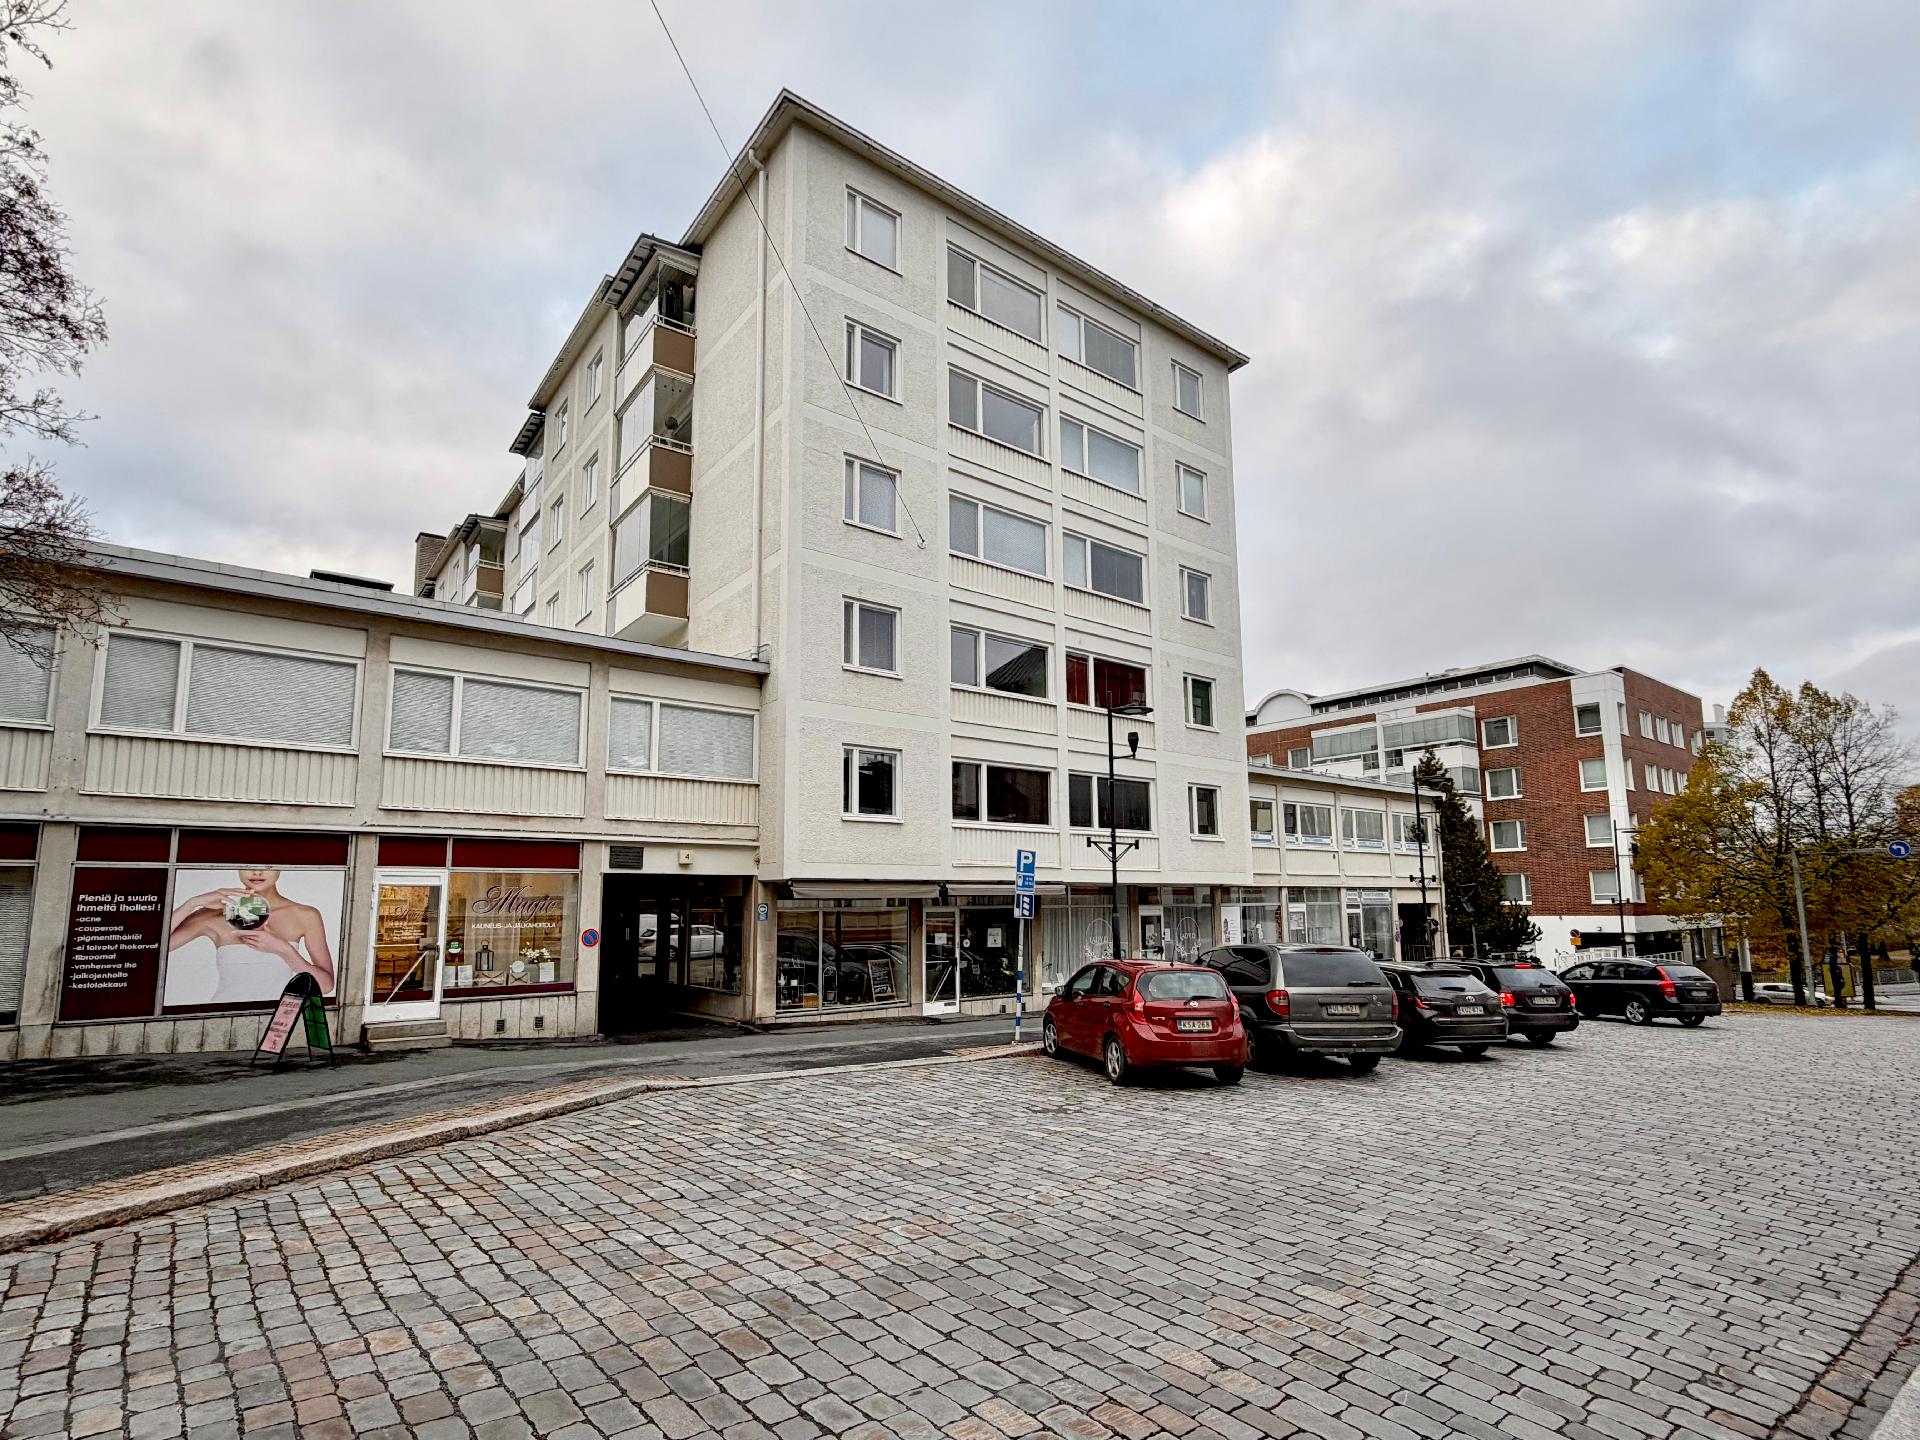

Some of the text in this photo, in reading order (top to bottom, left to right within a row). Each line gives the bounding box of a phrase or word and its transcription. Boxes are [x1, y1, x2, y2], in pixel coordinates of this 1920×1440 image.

[1020, 852, 1033, 872] P
[113, 894, 124, 903] ja
[472, 885, 557, 922] Magic
[74, 934, 142, 942] -pigmenttihäiriöt
[70, 972, 128, 980] -jalkojenhoito
